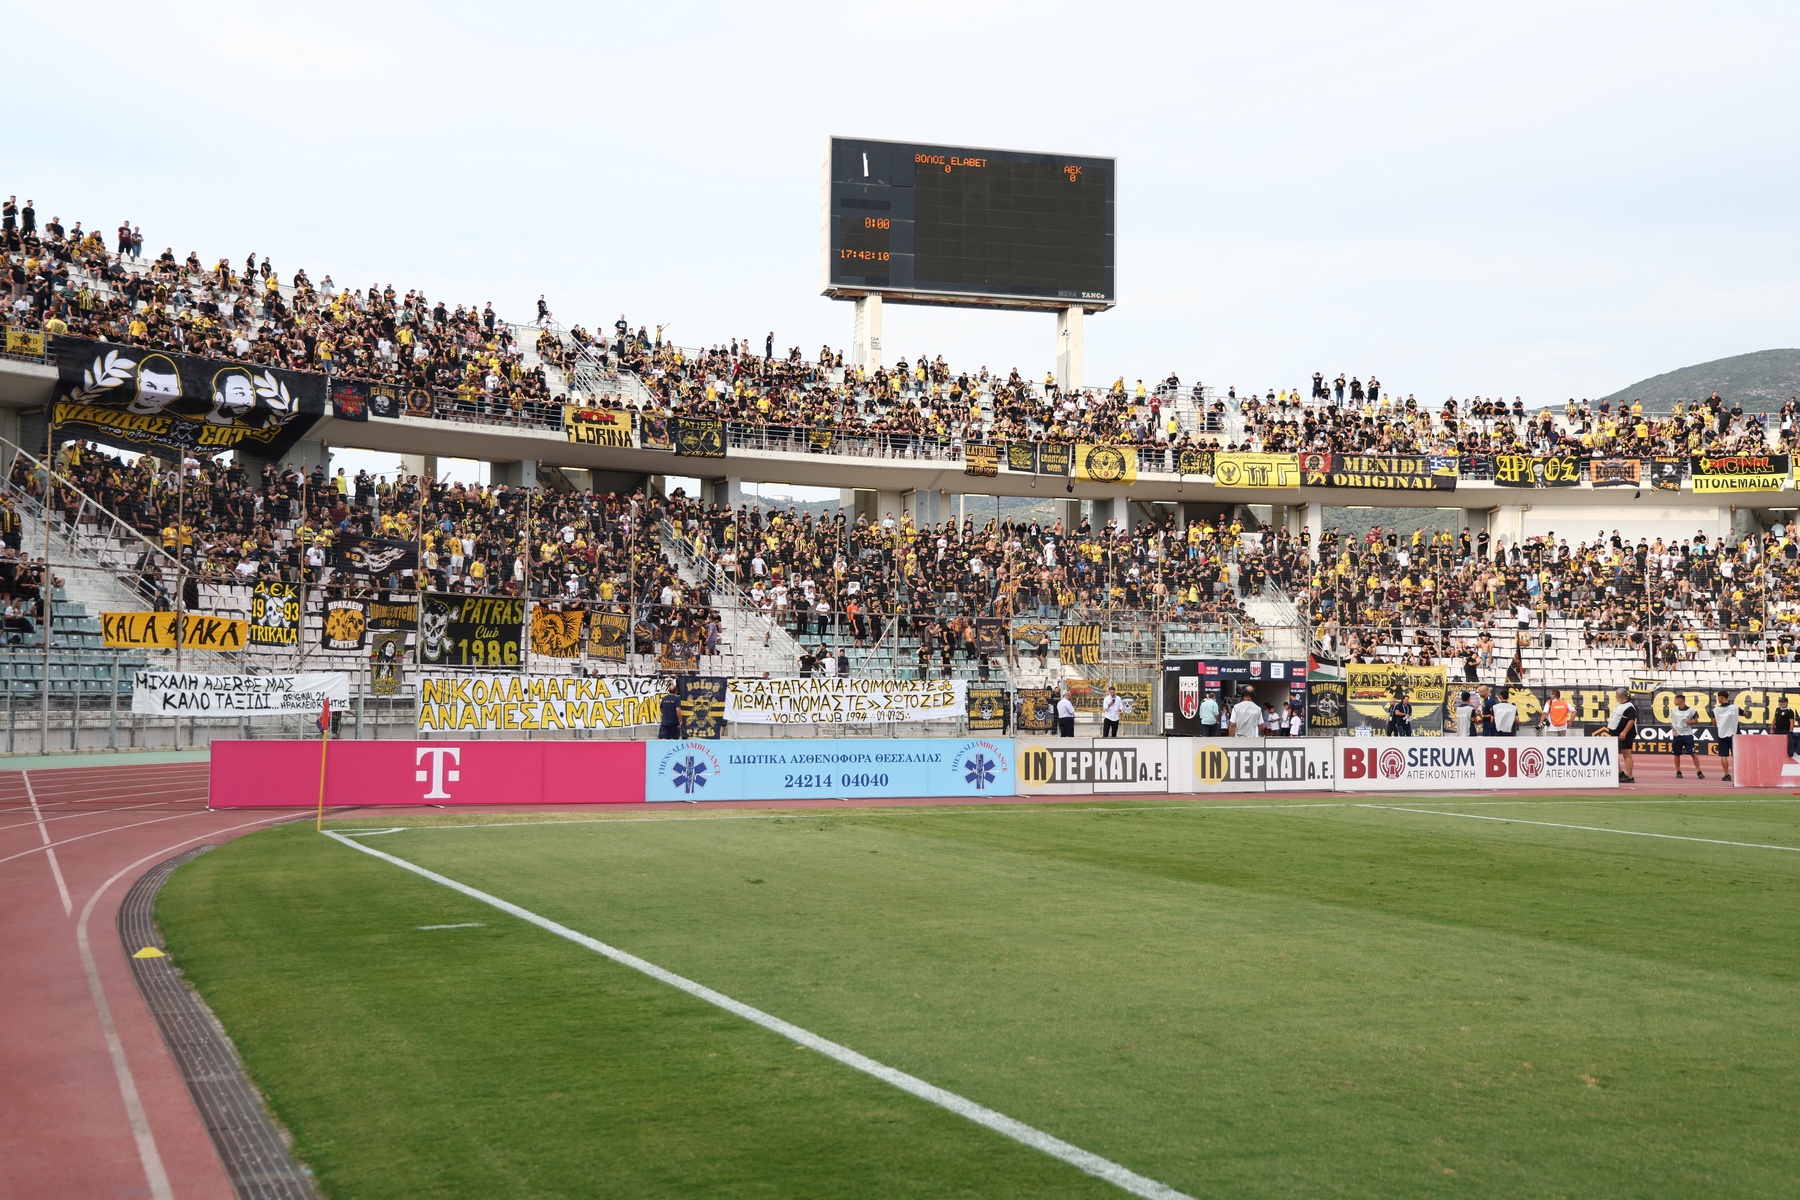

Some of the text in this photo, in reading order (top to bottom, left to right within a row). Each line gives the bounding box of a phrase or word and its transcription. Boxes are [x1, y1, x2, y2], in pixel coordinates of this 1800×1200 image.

[944, 164, 951, 174] 0
[951, 157, 987, 168] ELABET
[1064, 165, 1082, 175] ΑΕΚ
[1069, 174, 1076, 183] 0
[864, 218, 890, 229] 0:00
[840, 249, 890, 261] 17:42:10
[54, 403, 173, 435] ΝΙΚΟΛΑΣ
[679, 418, 723, 429] PATISSIA
[566, 424, 634, 448] FLORINA
[966, 445, 997, 456] KATERINI
[1342, 456, 1424, 475] MENIDI
[1333, 474, 1437, 490] ORIGINAL
[284, 602, 299, 622] 93
[328, 601, 363, 611] ΗΡΑΚΛΕΙΟ
[459, 598, 525, 624] PATRAS
[251, 625, 298, 644] TRIKALA
[475, 625, 499, 639] Club
[1061, 625, 1100, 645] KAVALA
[329, 640, 359, 649] ΚΡΗΤΗΣ
[458, 639, 518, 665] 1986
[135, 672, 198, 690] ΜΙΧΑΛΗ
[265, 677, 296, 693] ΜΑΣ
[162, 693, 210, 711] ΚΑΛΟ
[773, 711, 808, 724] VOLOS
[811, 711, 842, 723] CLUB
[729, 753, 942, 765] ΙΔΙΩΤΙΚΑ ΑΣΘΕΝΟΦΟΡΑ ΘΕΣΣΑΛΙΑΣ
[416, 747, 460, 799] T
[1407, 769, 1475, 779] ΑΠΕΙΚΟΝΙΣΤΙΚΗ
[1545, 769, 1611, 778] ΑΠΕΙΚΟΝΙΣΤΙΚΗ
[784, 773, 889, 788] 24214 04040
